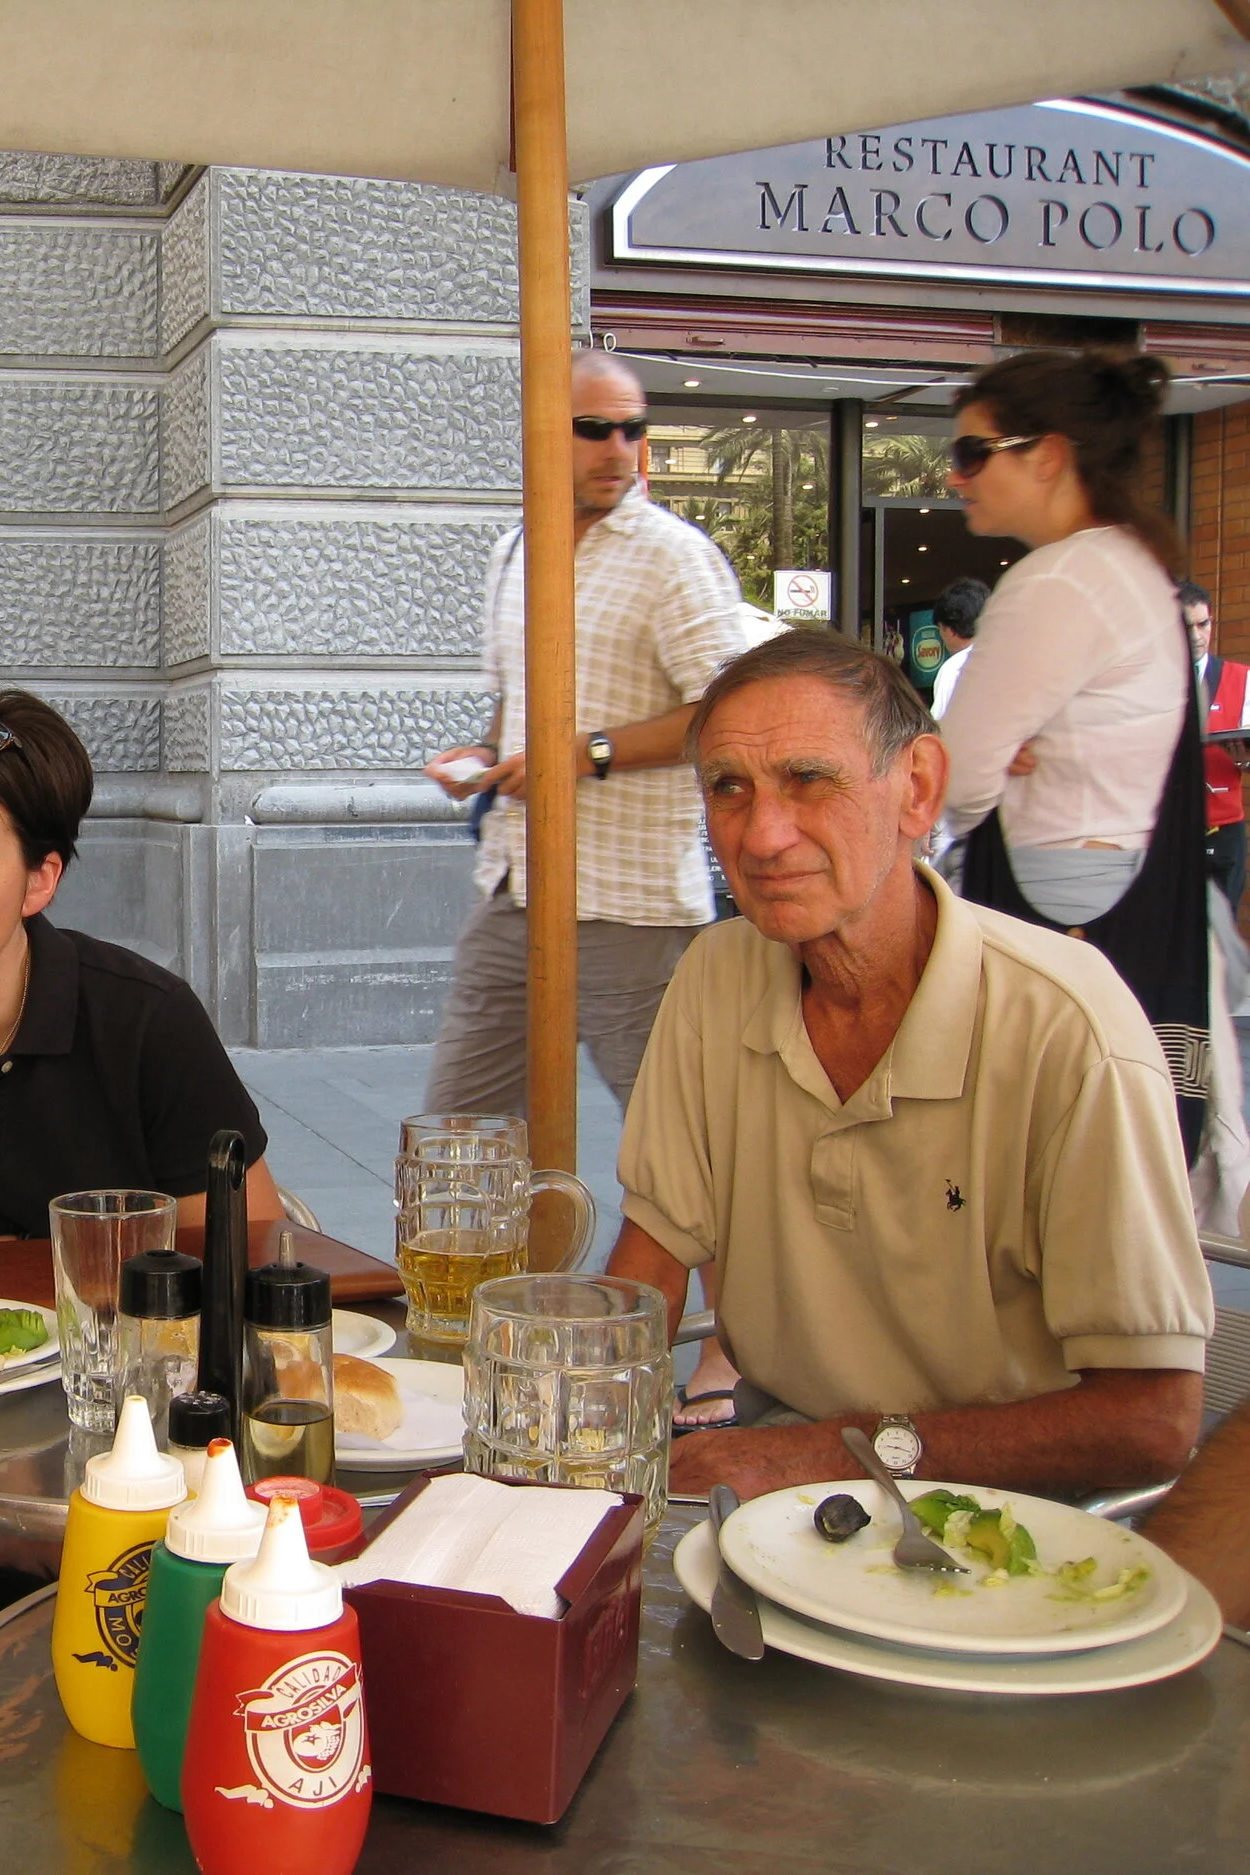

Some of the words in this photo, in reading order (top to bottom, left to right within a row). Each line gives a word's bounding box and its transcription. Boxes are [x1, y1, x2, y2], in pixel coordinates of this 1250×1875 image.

[823, 134, 1156, 189] RESTAURANT
[754, 181, 1010, 245] MARCO
[1039, 200, 1216, 257] POLO
[777, 608, 790, 617] NO
[793, 608, 827, 617] FUMAR
[276, 1665, 343, 1699] CALIDAD
[261, 1684, 347, 1728] AGROSILVA
[288, 1776, 337, 1797] AJI
